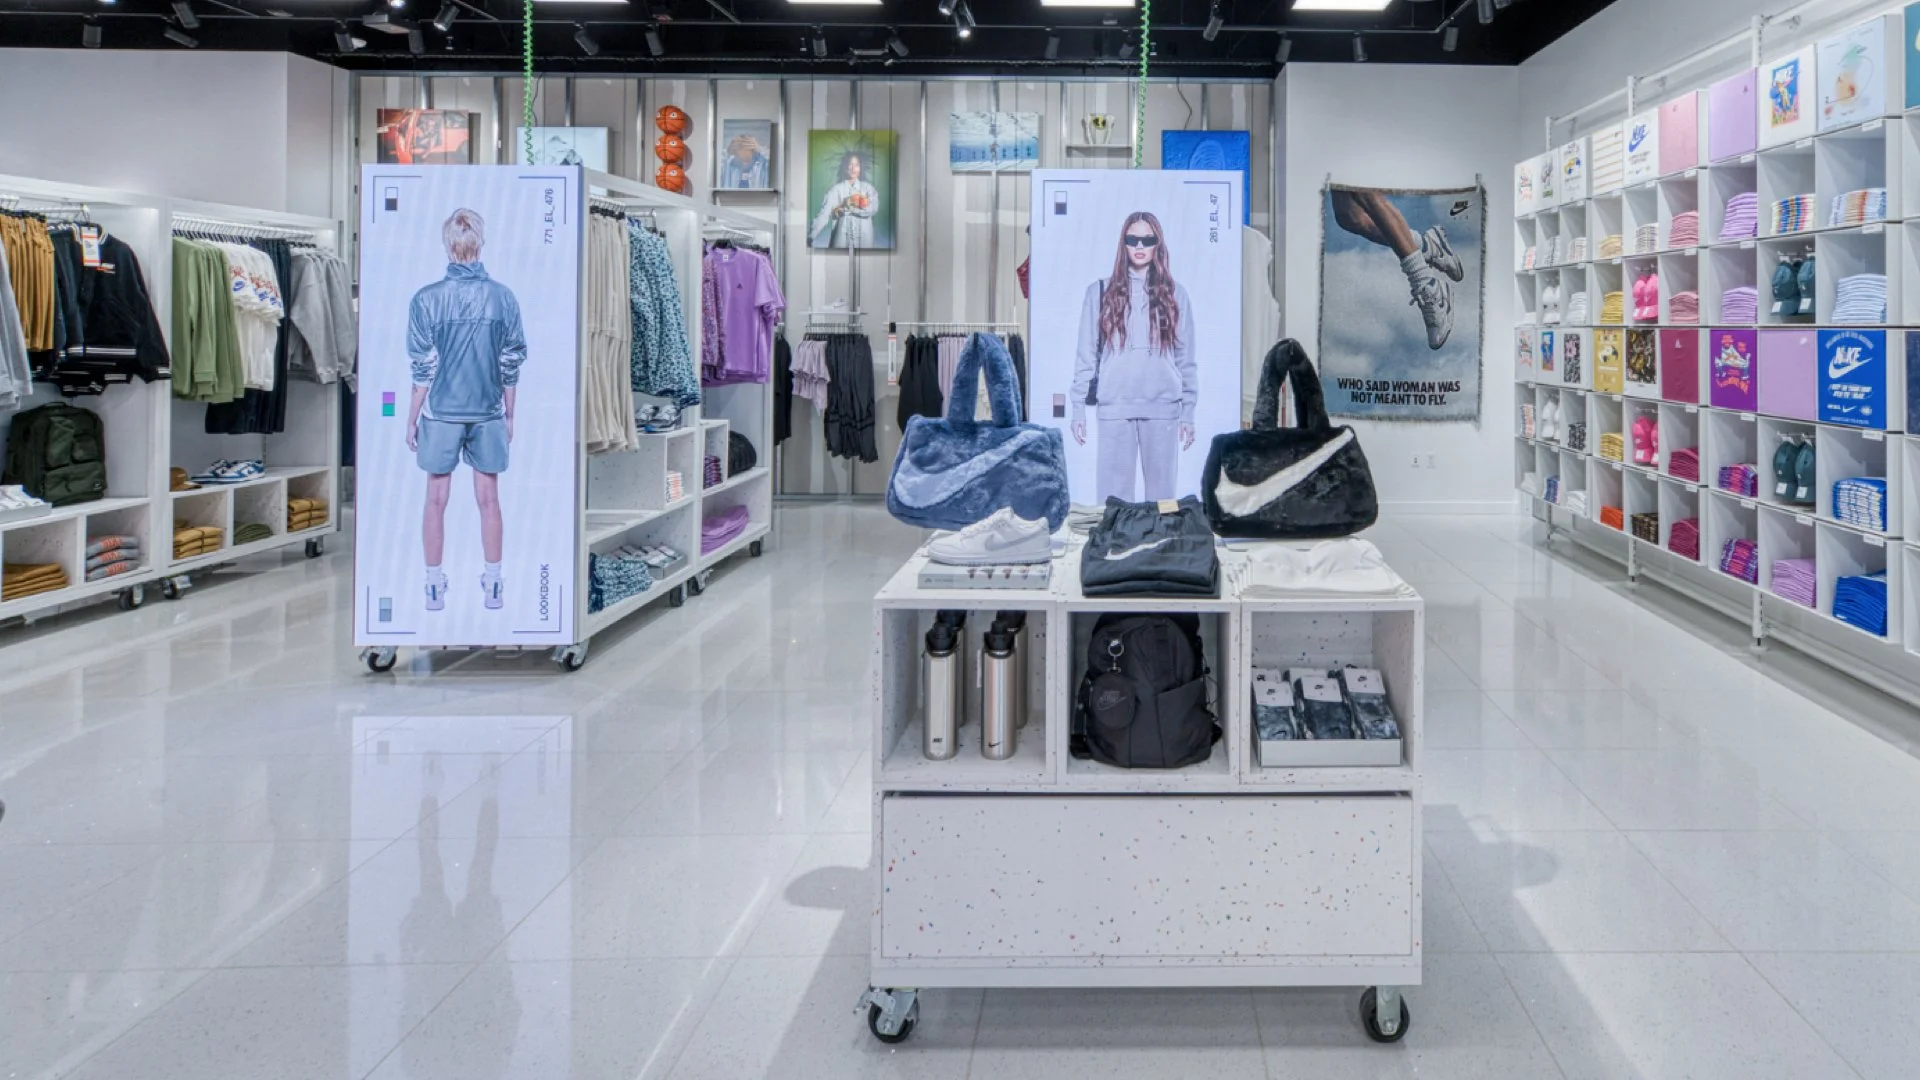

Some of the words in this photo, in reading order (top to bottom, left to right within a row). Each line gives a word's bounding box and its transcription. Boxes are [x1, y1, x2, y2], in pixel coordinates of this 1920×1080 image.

[1833, 346, 1862, 364] NIKE
[1337, 378, 1363, 391] WHO
[1365, 380, 1390, 392] SAID
[1392, 381, 1435, 393] WOMAN
[1436, 381, 1460, 392] WAS
[1351, 391, 1372, 404] NOT
[1374, 392, 1413, 405] MEANT
[1414, 394, 1426, 406] TO
[1428, 395, 1446, 406] FLY.
[540, 563, 549, 621] LOOKBOOK
